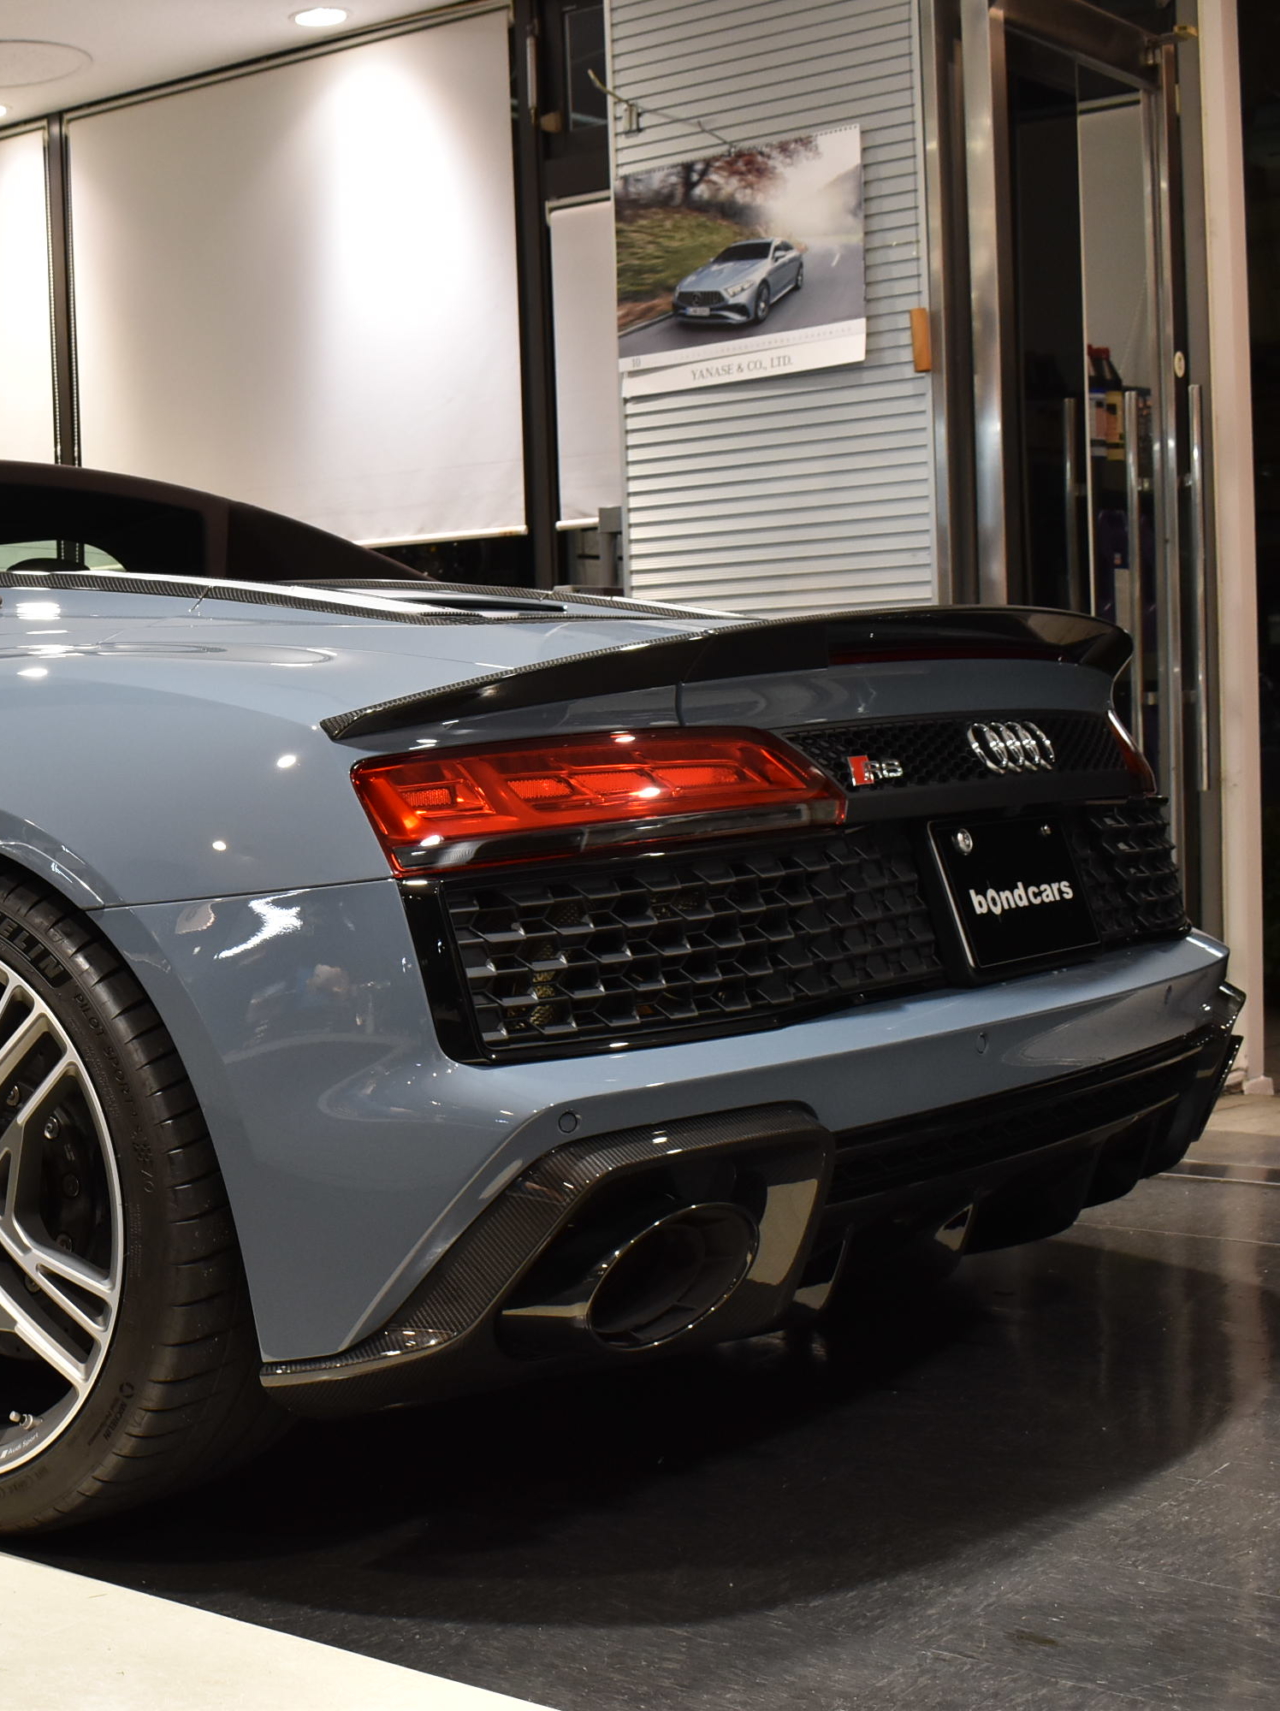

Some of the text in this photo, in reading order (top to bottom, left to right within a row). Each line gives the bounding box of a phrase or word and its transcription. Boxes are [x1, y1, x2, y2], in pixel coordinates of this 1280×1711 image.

[691, 355, 793, 381] YANASE & CO., LTD.
[862, 759, 904, 782] R8
[73, 992, 105, 1037] PILOT
[104, 1046, 134, 1103] SPORT
